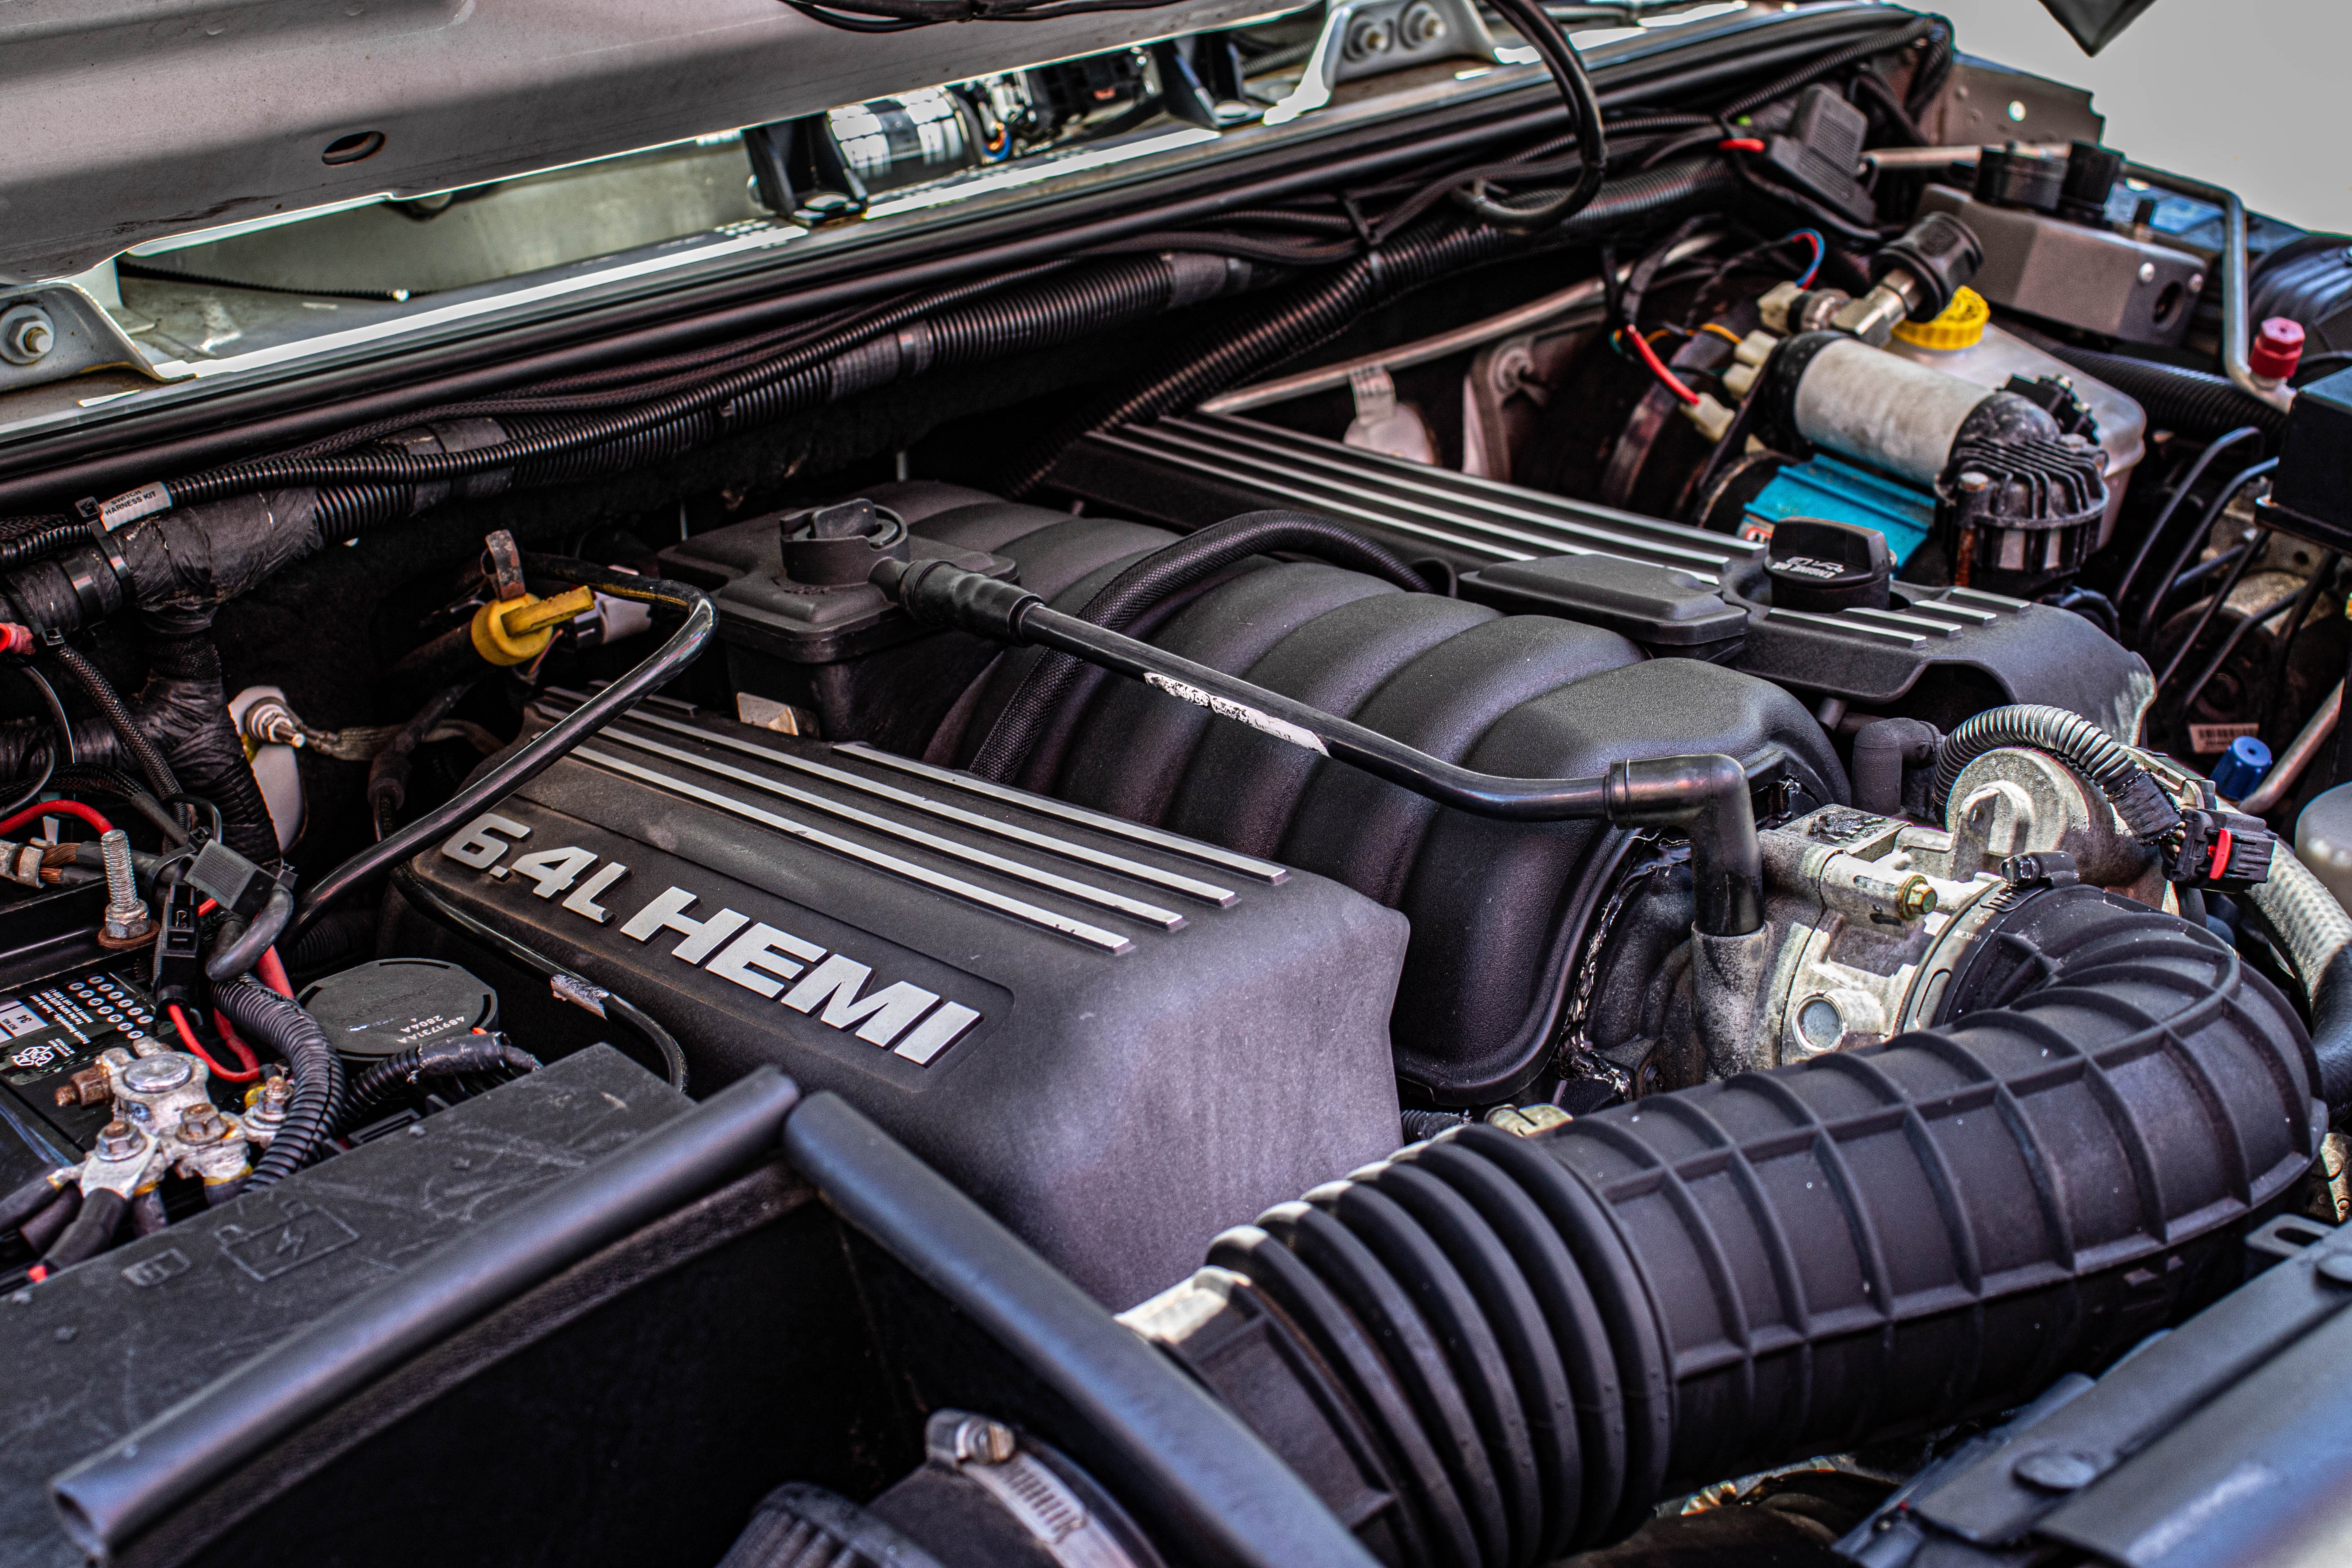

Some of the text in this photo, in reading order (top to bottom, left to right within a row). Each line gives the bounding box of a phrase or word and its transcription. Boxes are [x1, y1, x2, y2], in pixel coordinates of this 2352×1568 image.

[105, 490, 156, 516] HARNESS KIT
[111, 490, 141, 504] SWITCH
[441, 813, 980, 1065] 6.4L HEMI
[49, 998, 63, 1006] AUTO
[58, 1005, 72, 1015] NAPA
[16, 1014, 32, 1023] 34
[77, 1011, 94, 1023] nearest
[396, 1016, 465, 1044] 4891731AA
[400, 1015, 443, 1033] 2804A
[74, 1031, 91, 1044] Recycle
